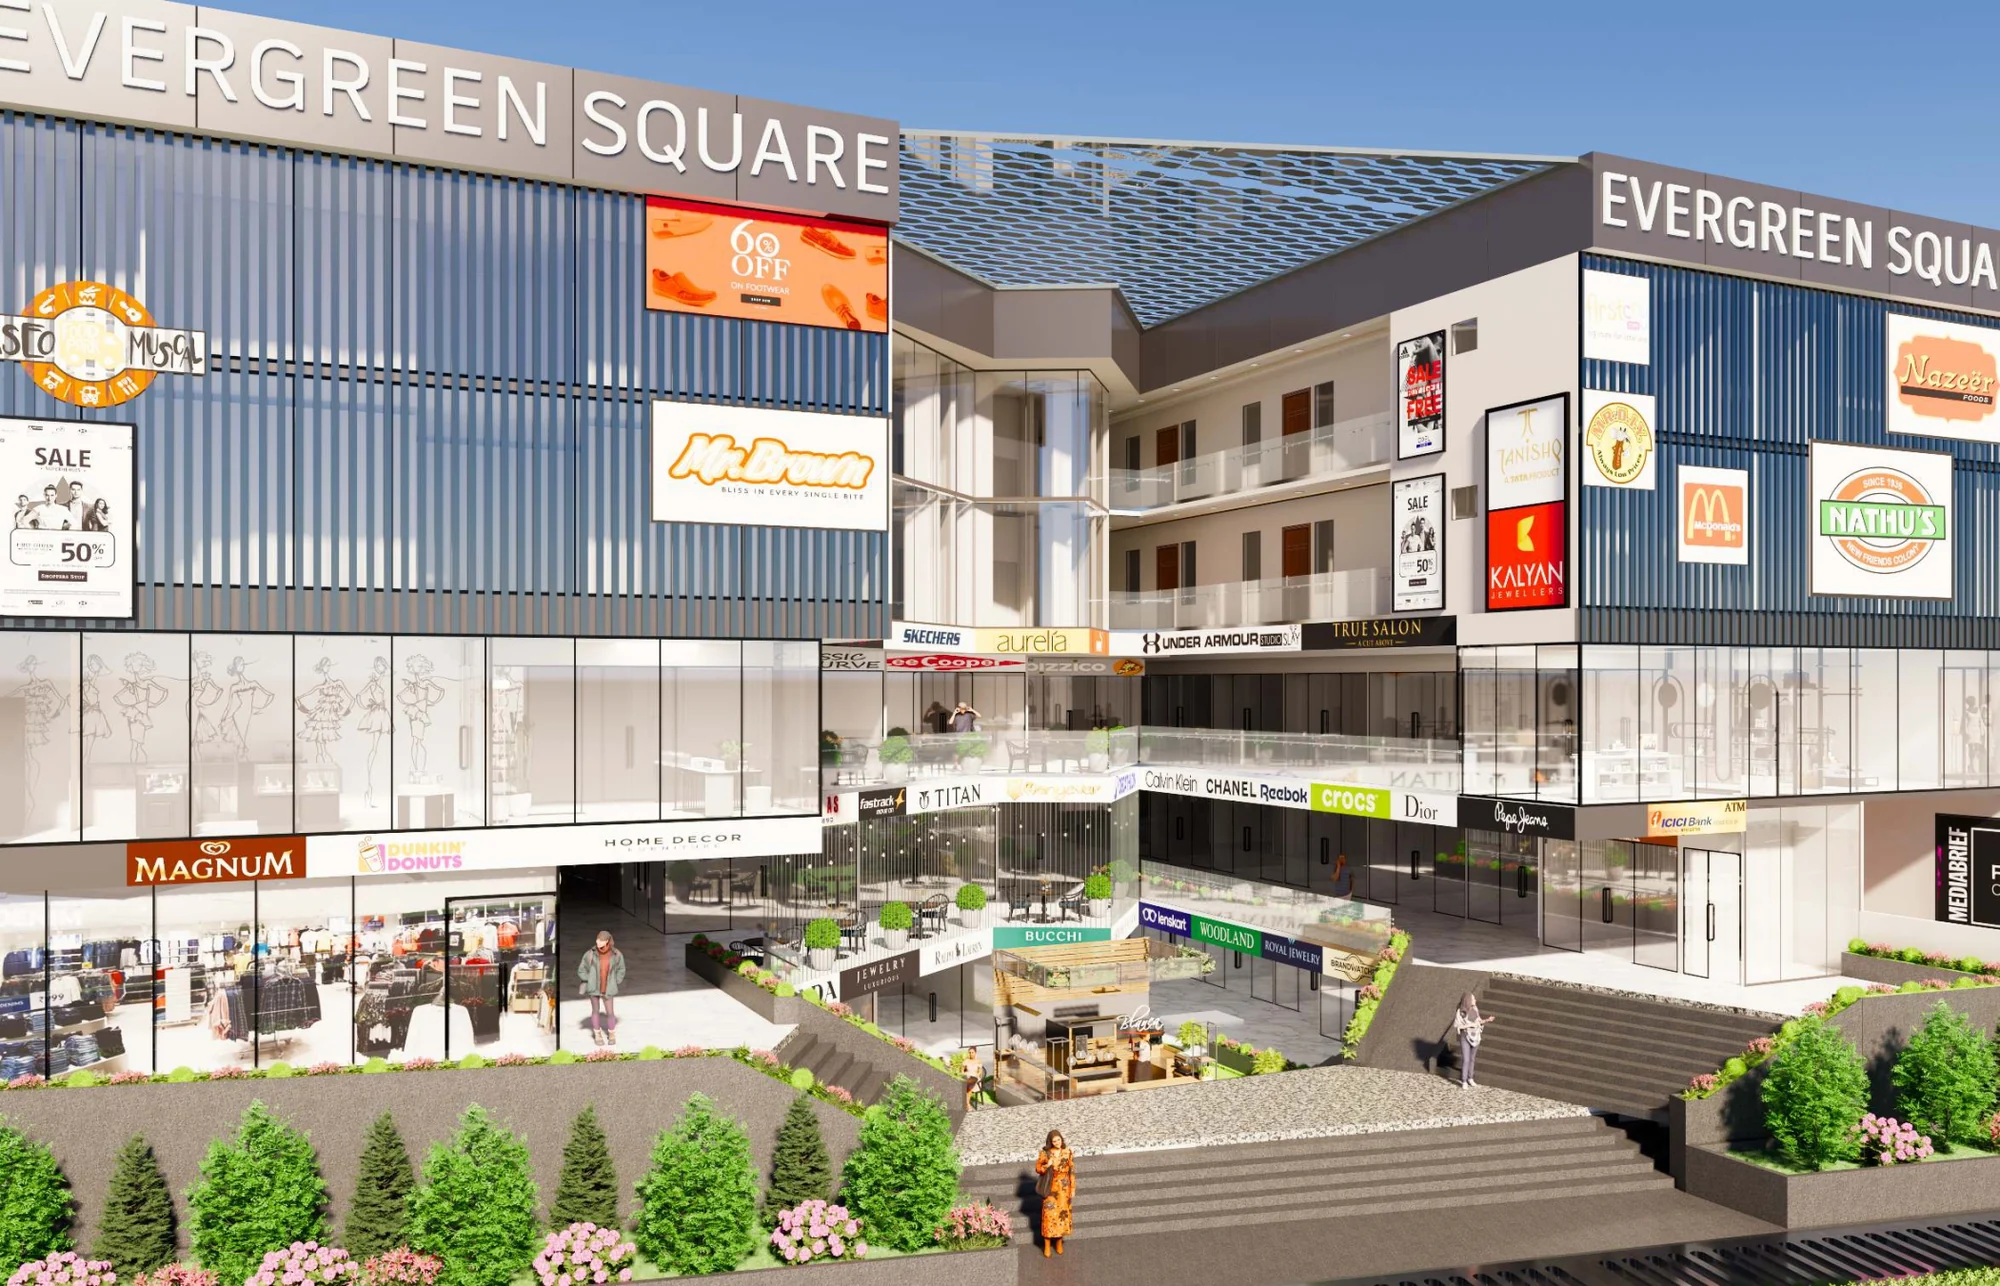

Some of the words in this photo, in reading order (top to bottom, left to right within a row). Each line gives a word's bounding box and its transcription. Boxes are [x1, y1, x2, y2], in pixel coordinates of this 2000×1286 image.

[0, 0, 546, 147] EVERGREEN
[581, 90, 890, 195] SQUARE
[1602, 171, 1872, 270] EVERGREEN
[1886, 226, 1998, 291] SQUA
[731, 254, 791, 281] OFF
[730, 281, 744, 290] ON
[745, 283, 790, 295] FOOTWEAR
[0, 322, 55, 359] SEO
[1407, 360, 1441, 386] SALE
[1899, 353, 1995, 393] Nazeër
[1407, 394, 1442, 420] FREE
[1962, 394, 1989, 403] FOODS
[35, 447, 91, 468] SALE
[1511, 472, 1529, 483] TATA
[1529, 467, 1560, 481] PRODUCT
[1862, 477, 1885, 488] SINCE
[721, 486, 749, 494] BLISS
[769, 489, 799, 497] EVERY
[804, 491, 839, 499] SINGLE
[1407, 495, 1429, 511] SALE
[1829, 506, 1937, 536] NATHU'S
[1846, 541, 1863, 560] NEW
[1863, 554, 1893, 567] FRIENDS
[1893, 543, 1920, 565] COLONY
[1491, 561, 1563, 589] KALYAN
[1491, 587, 1563, 600] JEWELLERS
[903, 628, 961, 646] SKECHERS
[1332, 621, 1368, 638] TRUE
[1373, 618, 1422, 636] SALON
[1162, 635, 1201, 649] UNDER
[1204, 632, 1259, 648] ARMOUR
[1260, 635, 1282, 646] STUDIO
[1145, 771, 1174, 789] Calvin
[1175, 774, 1198, 793] Klein
[1206, 779, 1257, 798] CHANEL
[860, 796, 894, 810] fastrack
[935, 784, 981, 808] TITAN
[1260, 784, 1308, 804] Reebok
[1321, 788, 1377, 813] crocs
[1404, 795, 1439, 821] Dior
[1494, 801, 1518, 831] Pepe
[1517, 804, 1548, 834] Jeans
[1724, 801, 1746, 813] ATM
[1661, 816, 1687, 828] ICICI
[1688, 815, 1712, 827] Bank
[388, 841, 466, 856] DUNKIN'
[605, 837, 664, 847] HOME
[672, 833, 742, 844] DECOR
[134, 849, 294, 883] MAGNUM
[388, 855, 463, 871] DONUTS
[1948, 826, 1968, 923] MEDIABRIEF
[1157, 910, 1188, 932] lenskart
[1025, 930, 1083, 943] BUCCHI
[1200, 922, 1254, 949] WOODLAND
[1264, 939, 1288, 957] ROYAL
[1287, 946, 1321, 966] JEWELRY
[856, 957, 906, 984] JEWELRY
[863, 974, 900, 991] LUXURIOUS
